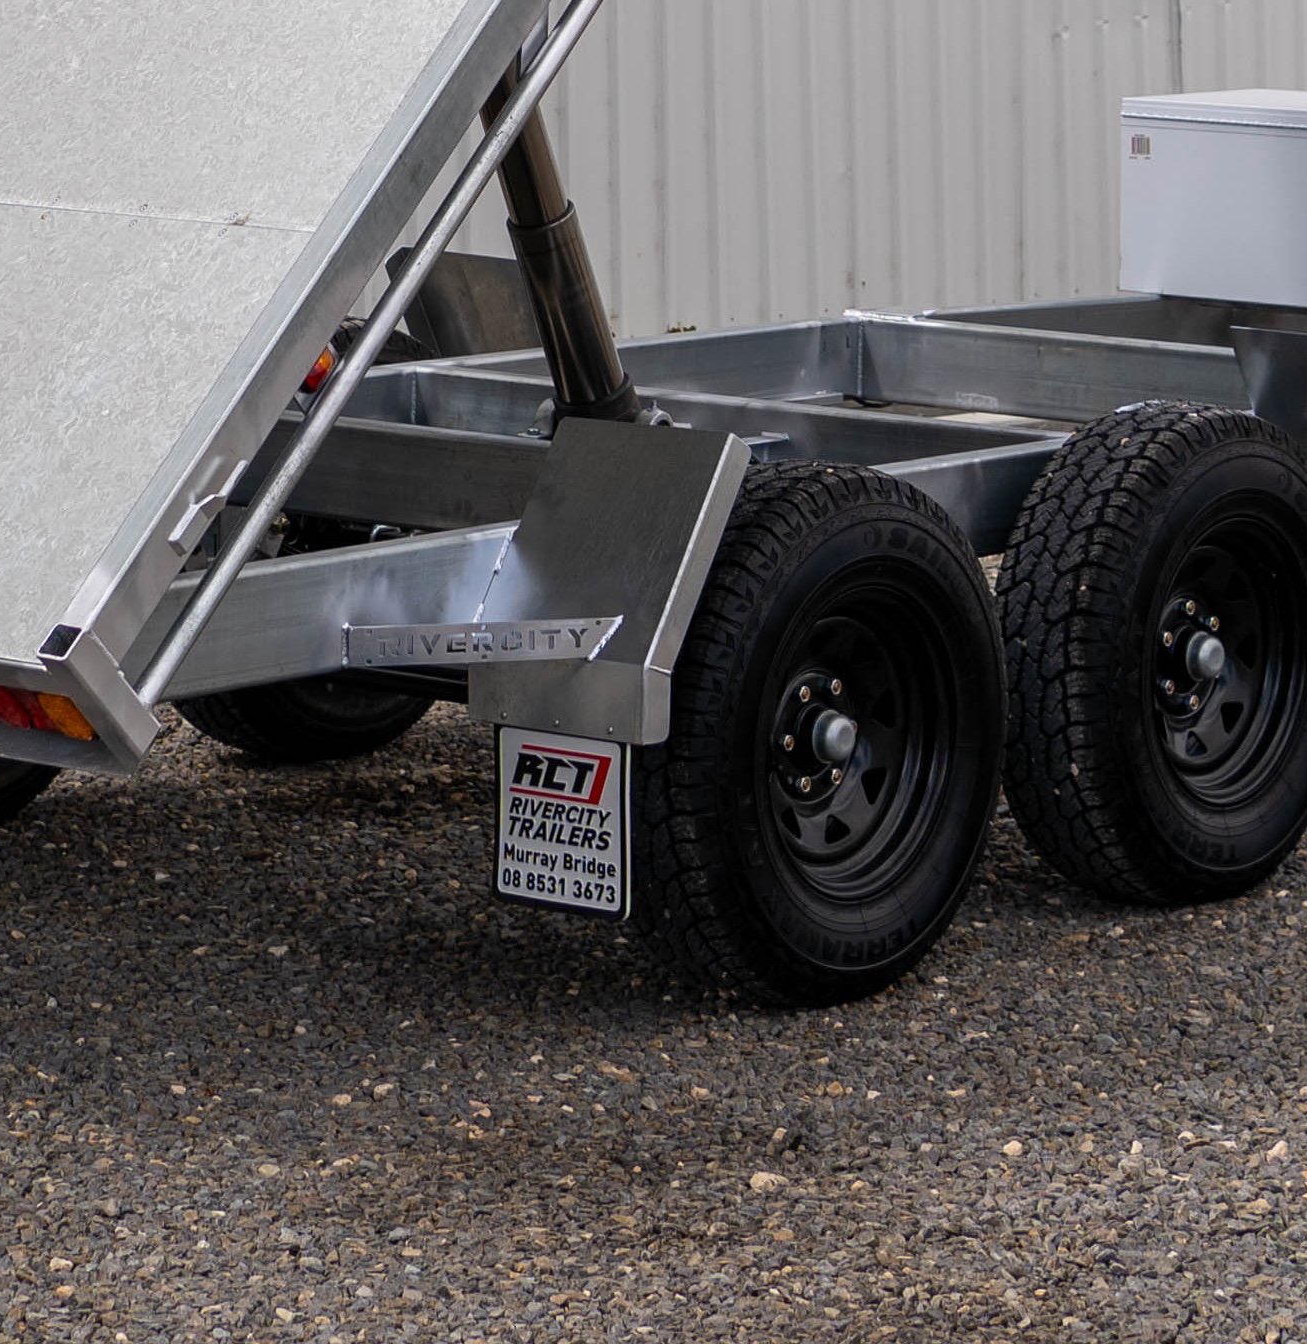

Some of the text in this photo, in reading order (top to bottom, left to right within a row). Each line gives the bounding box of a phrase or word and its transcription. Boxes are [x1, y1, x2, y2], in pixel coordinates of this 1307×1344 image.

[377, 628, 590, 657] RIVERCITY
[512, 752, 595, 794] RCT
[509, 797, 612, 829] RIVERCITY
[508, 816, 612, 851] TRAILERS
[503, 843, 616, 880] Murray Bridge
[502, 868, 616, 904] 08 8531 3673
